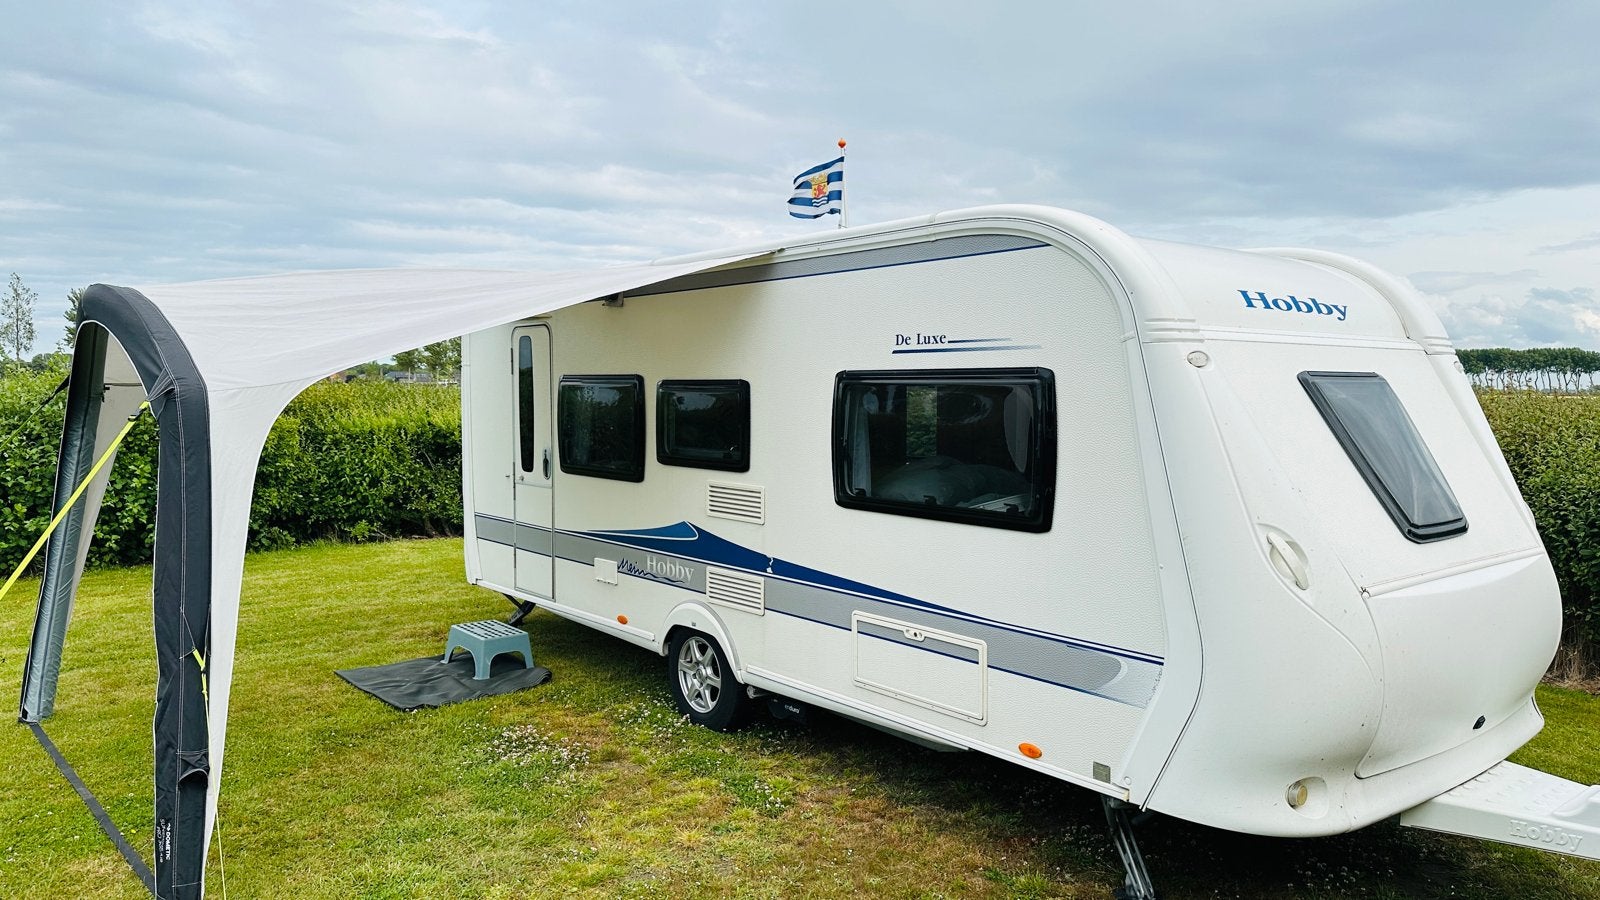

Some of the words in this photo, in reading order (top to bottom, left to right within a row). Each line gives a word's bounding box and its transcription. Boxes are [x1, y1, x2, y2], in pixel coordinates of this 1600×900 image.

[1237, 289, 1347, 321] Hobby
[895, 334, 911, 346] De
[916, 333, 946, 345] Luxe
[617, 557, 646, 577] Mein
[646, 554, 694, 582] Hobby
[1510, 819, 1583, 852] Hobby
